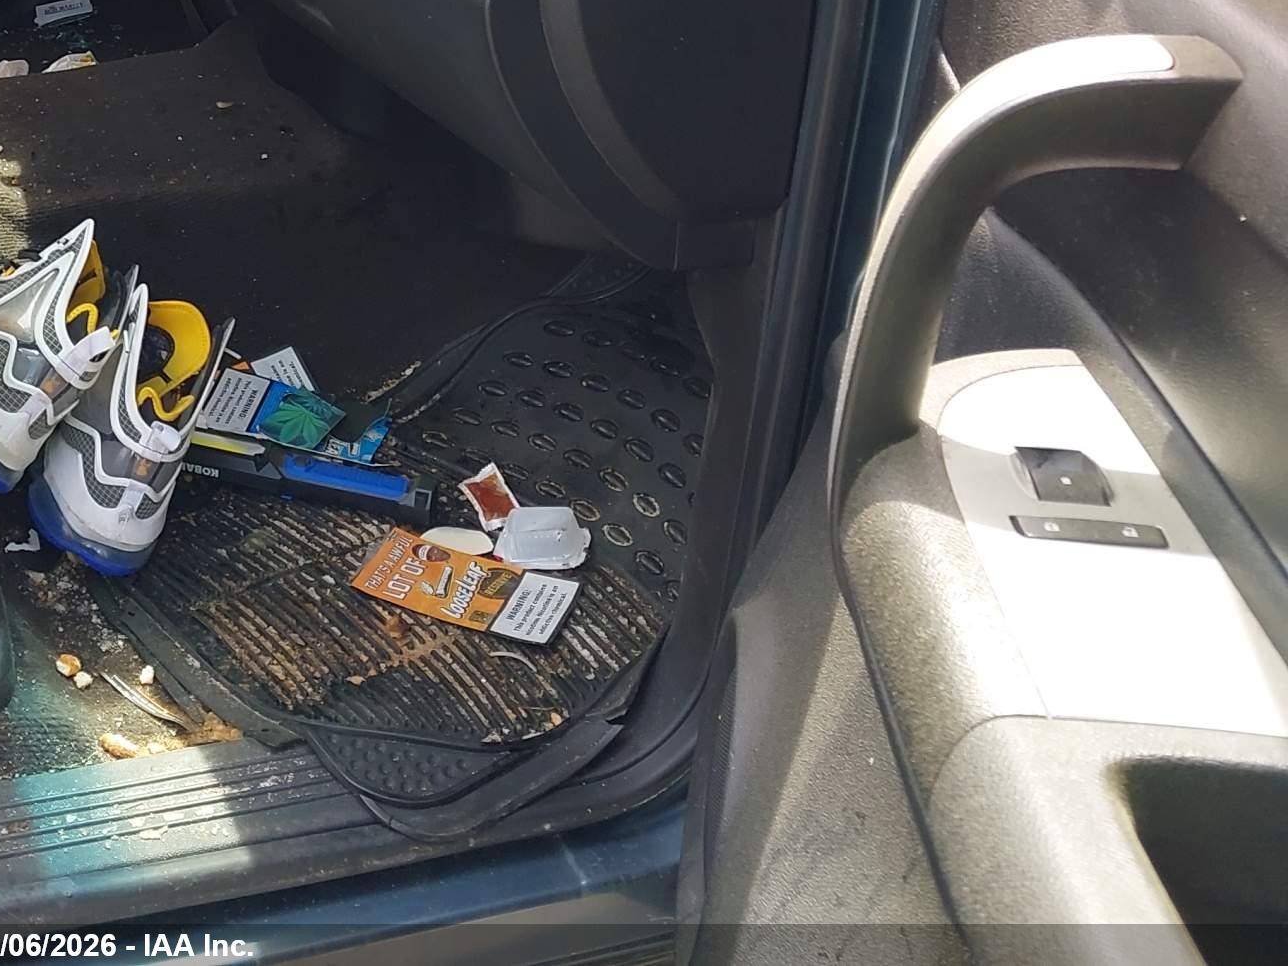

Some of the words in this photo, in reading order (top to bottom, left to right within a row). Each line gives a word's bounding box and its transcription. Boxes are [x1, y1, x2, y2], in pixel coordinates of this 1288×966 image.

[388, 536, 413, 563] AWFUL
[364, 564, 391, 590] THAT'S
[383, 559, 397, 569] A
[382, 573, 416, 599] LOT
[401, 557, 427, 576] OF
[506, 589, 531, 620] WARNING:
[513, 621, 524, 632] This
[522, 604, 536, 622] product
